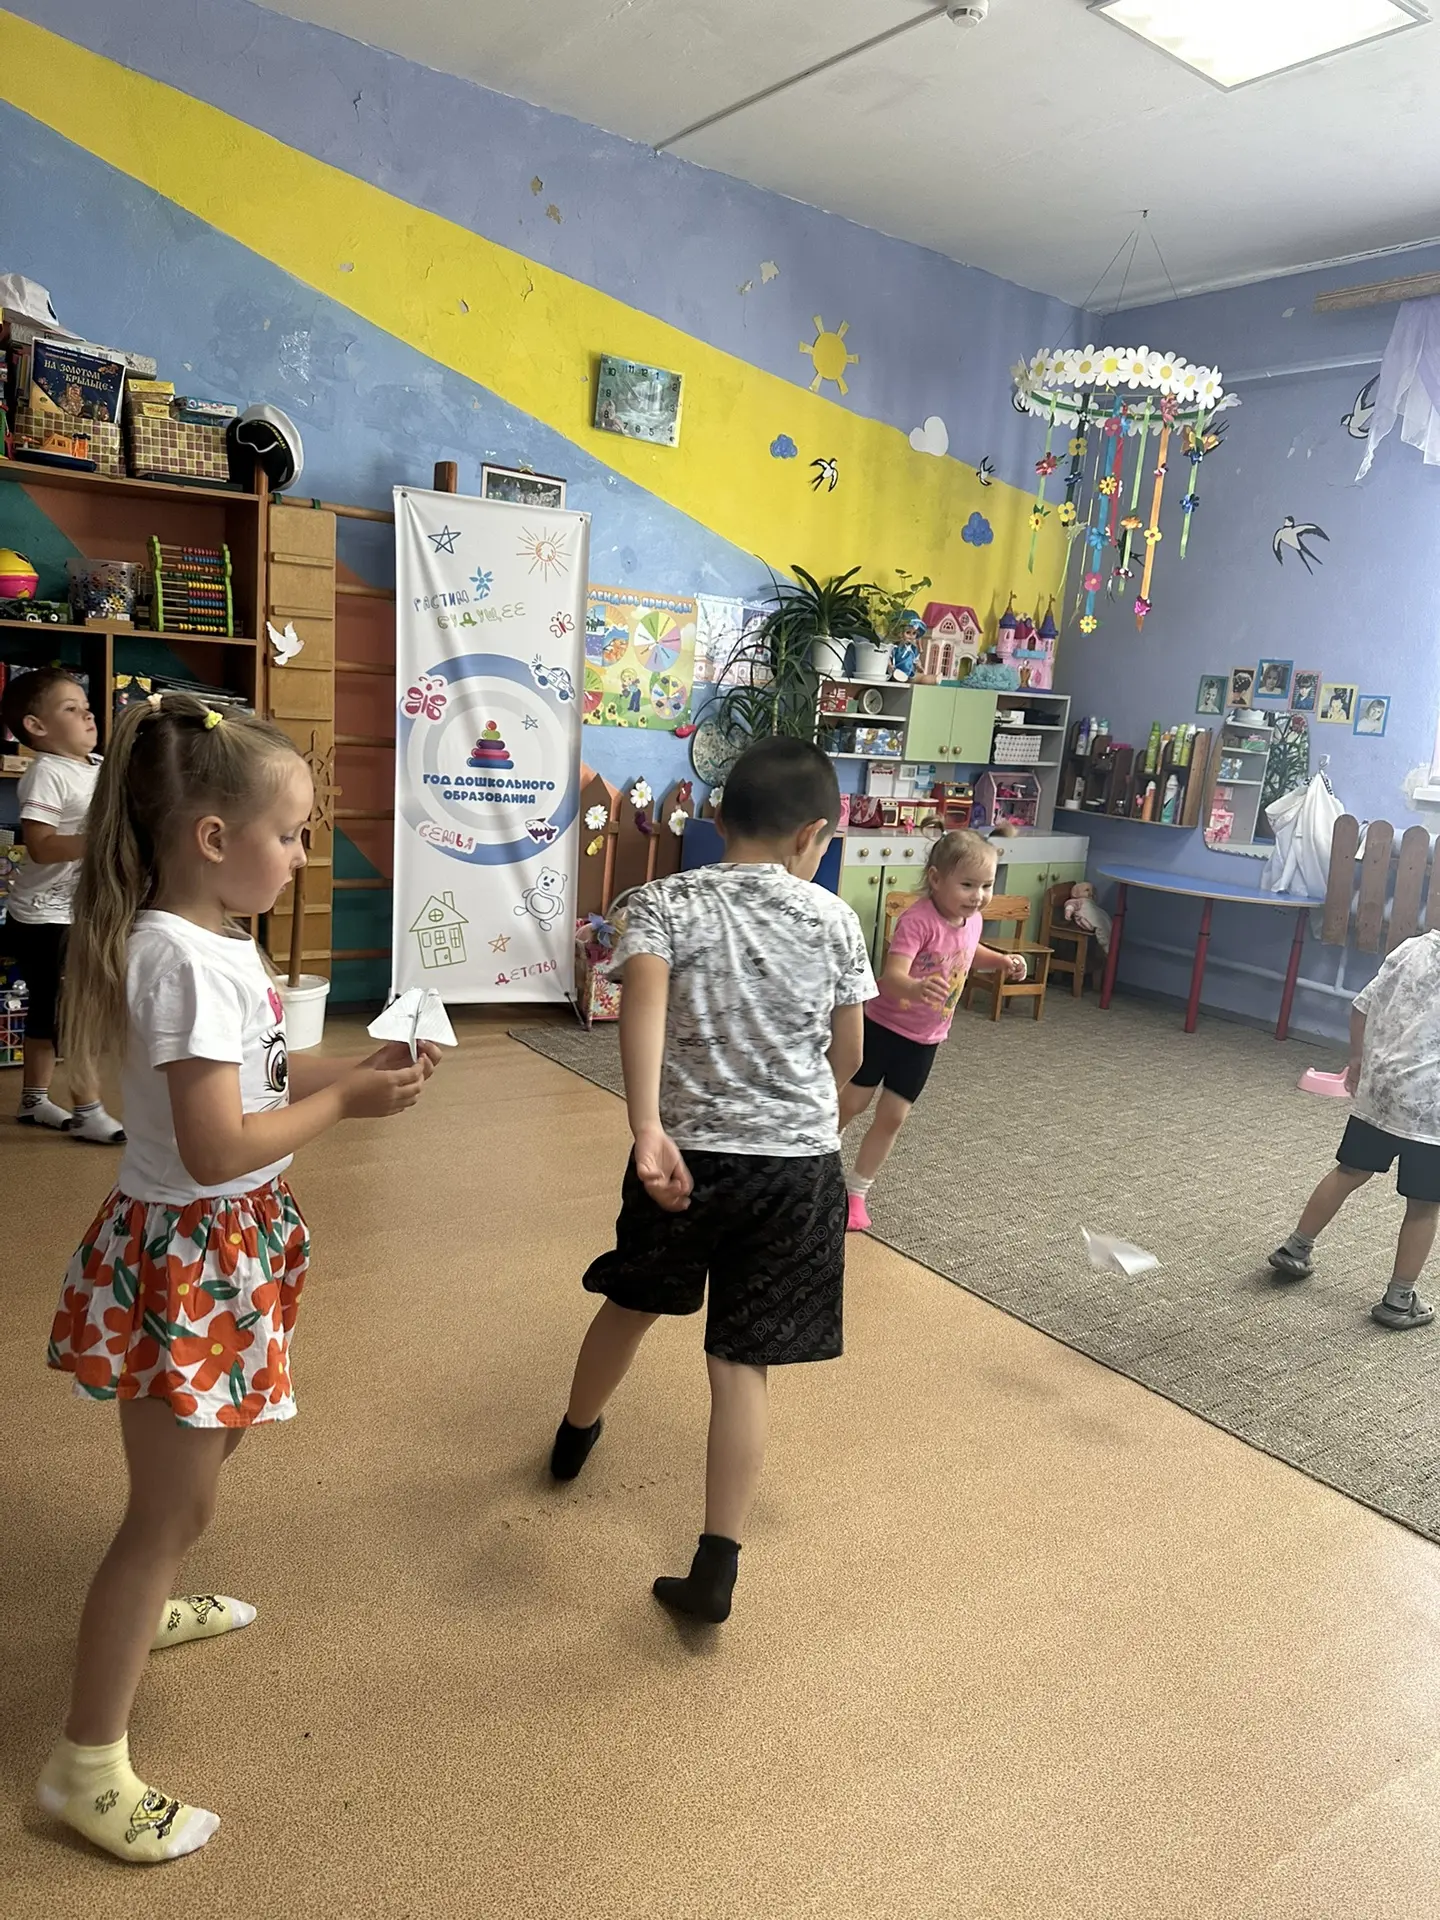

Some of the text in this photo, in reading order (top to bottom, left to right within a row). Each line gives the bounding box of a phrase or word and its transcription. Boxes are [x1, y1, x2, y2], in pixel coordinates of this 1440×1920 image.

[44, 359, 101, 381] НА ЗОЛОТОМ
[587, 589, 693, 614] ЛЕНДАРЬ ПРИРОДЫ
[437, 602, 527, 630] БУДУЩЕЕ
[423, 773, 555, 791] ГОД ДОШКОЛЬНОГО
[442, 789, 536, 805] ОБРАЗОВАНИЯ
[419, 824, 474, 850] СЕМЬЯ
[494, 959, 557, 986] ДЕТСТВО
